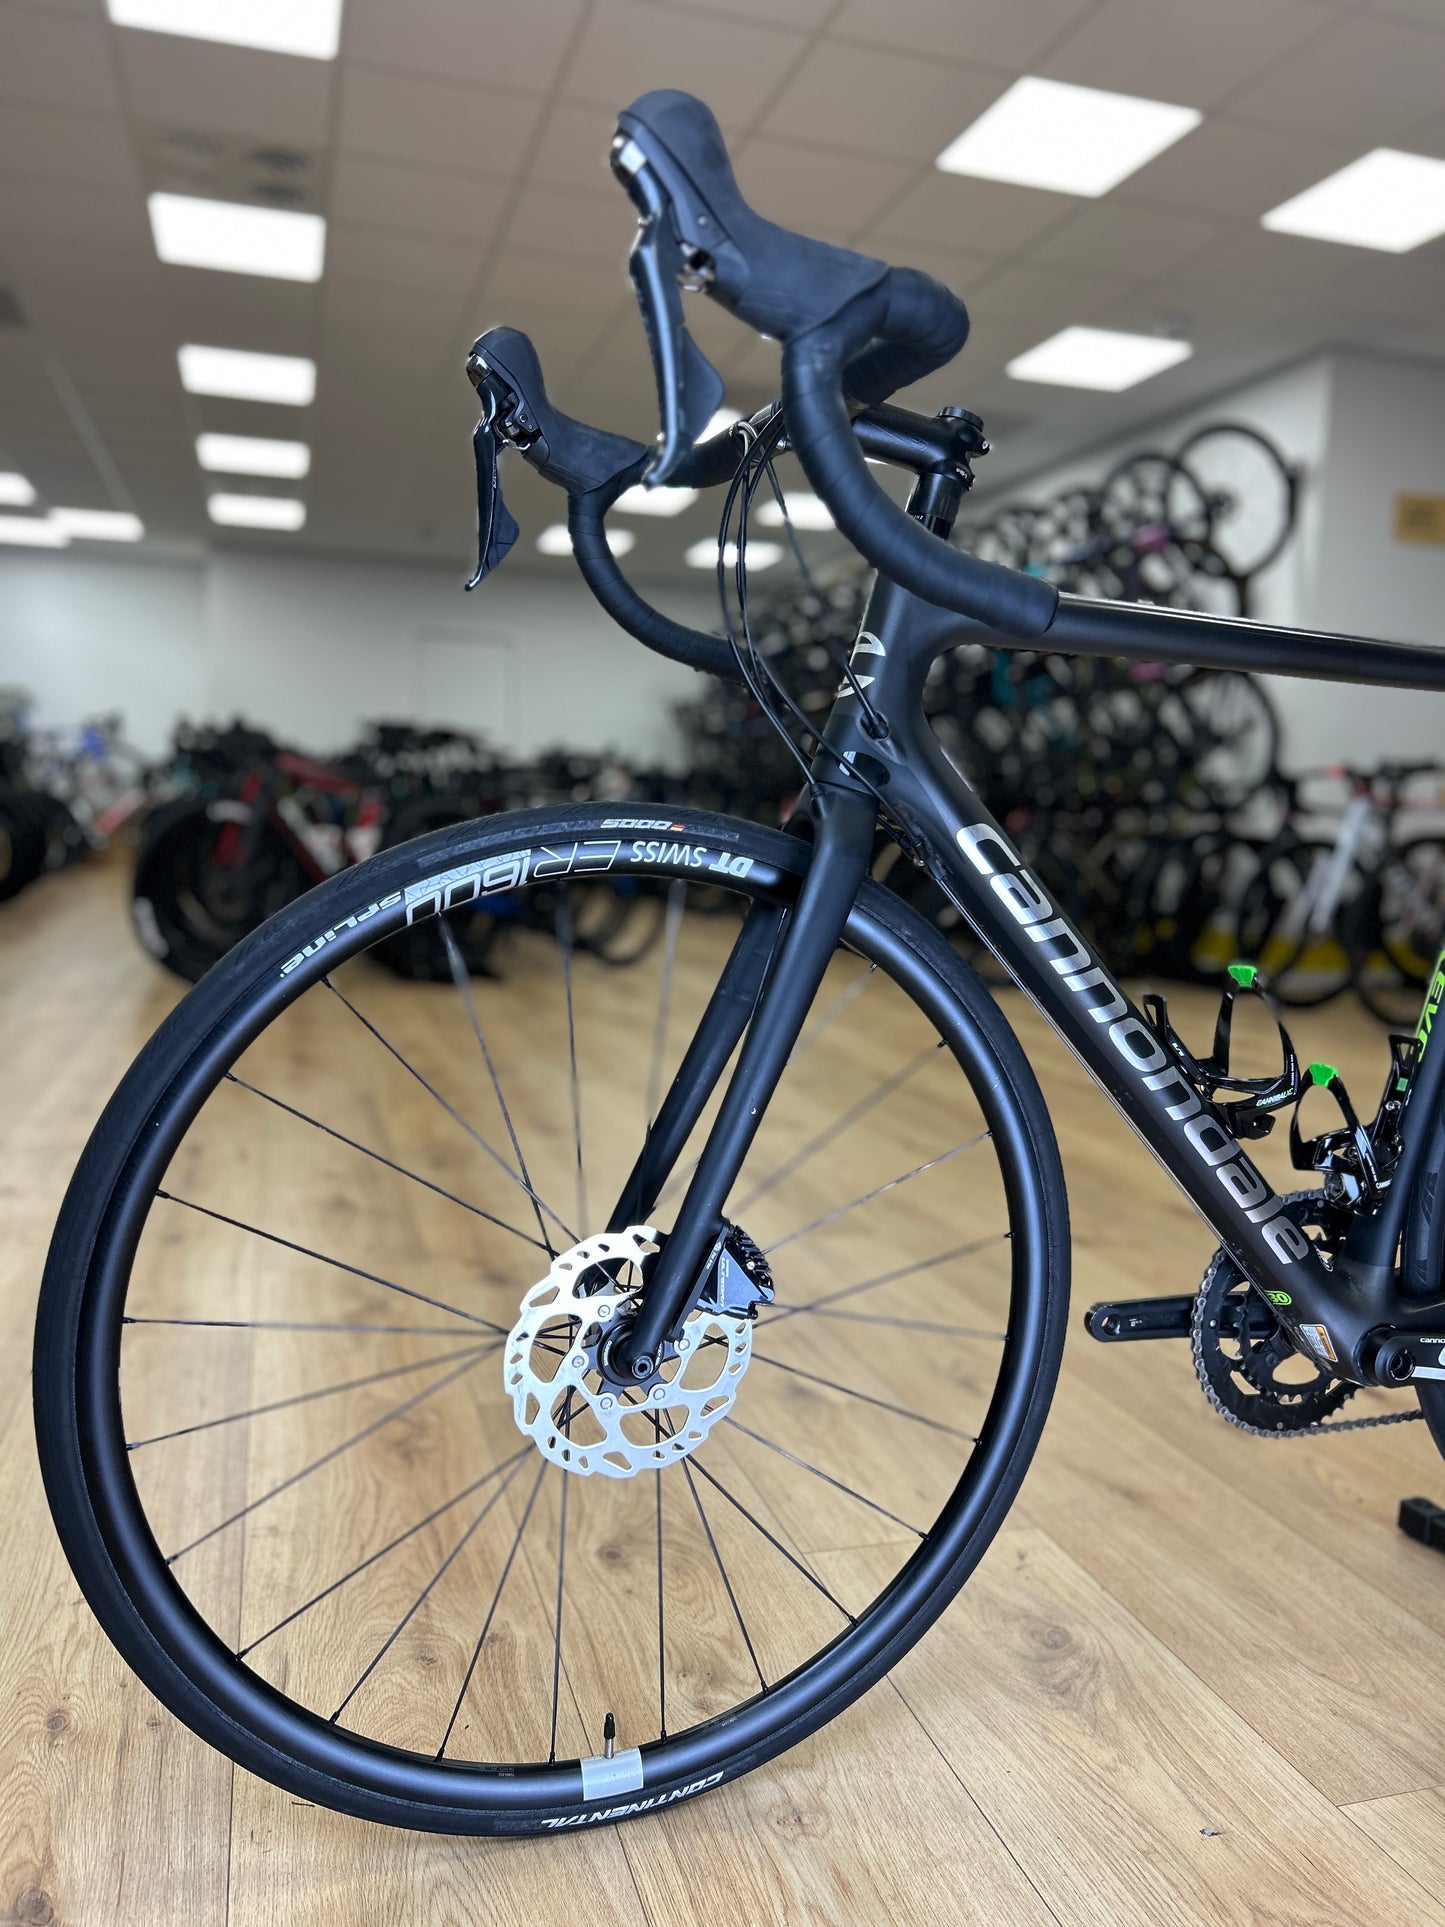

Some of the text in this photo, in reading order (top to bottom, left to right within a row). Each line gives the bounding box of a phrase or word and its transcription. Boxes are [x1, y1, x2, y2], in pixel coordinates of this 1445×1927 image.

[600, 818, 672, 830] 5000
[630, 840, 707, 868] SWISS
[709, 851, 754, 878] DT
[956, 823, 1310, 1265] cannondale
[540, 1770, 724, 1829] CONTINENTAL
